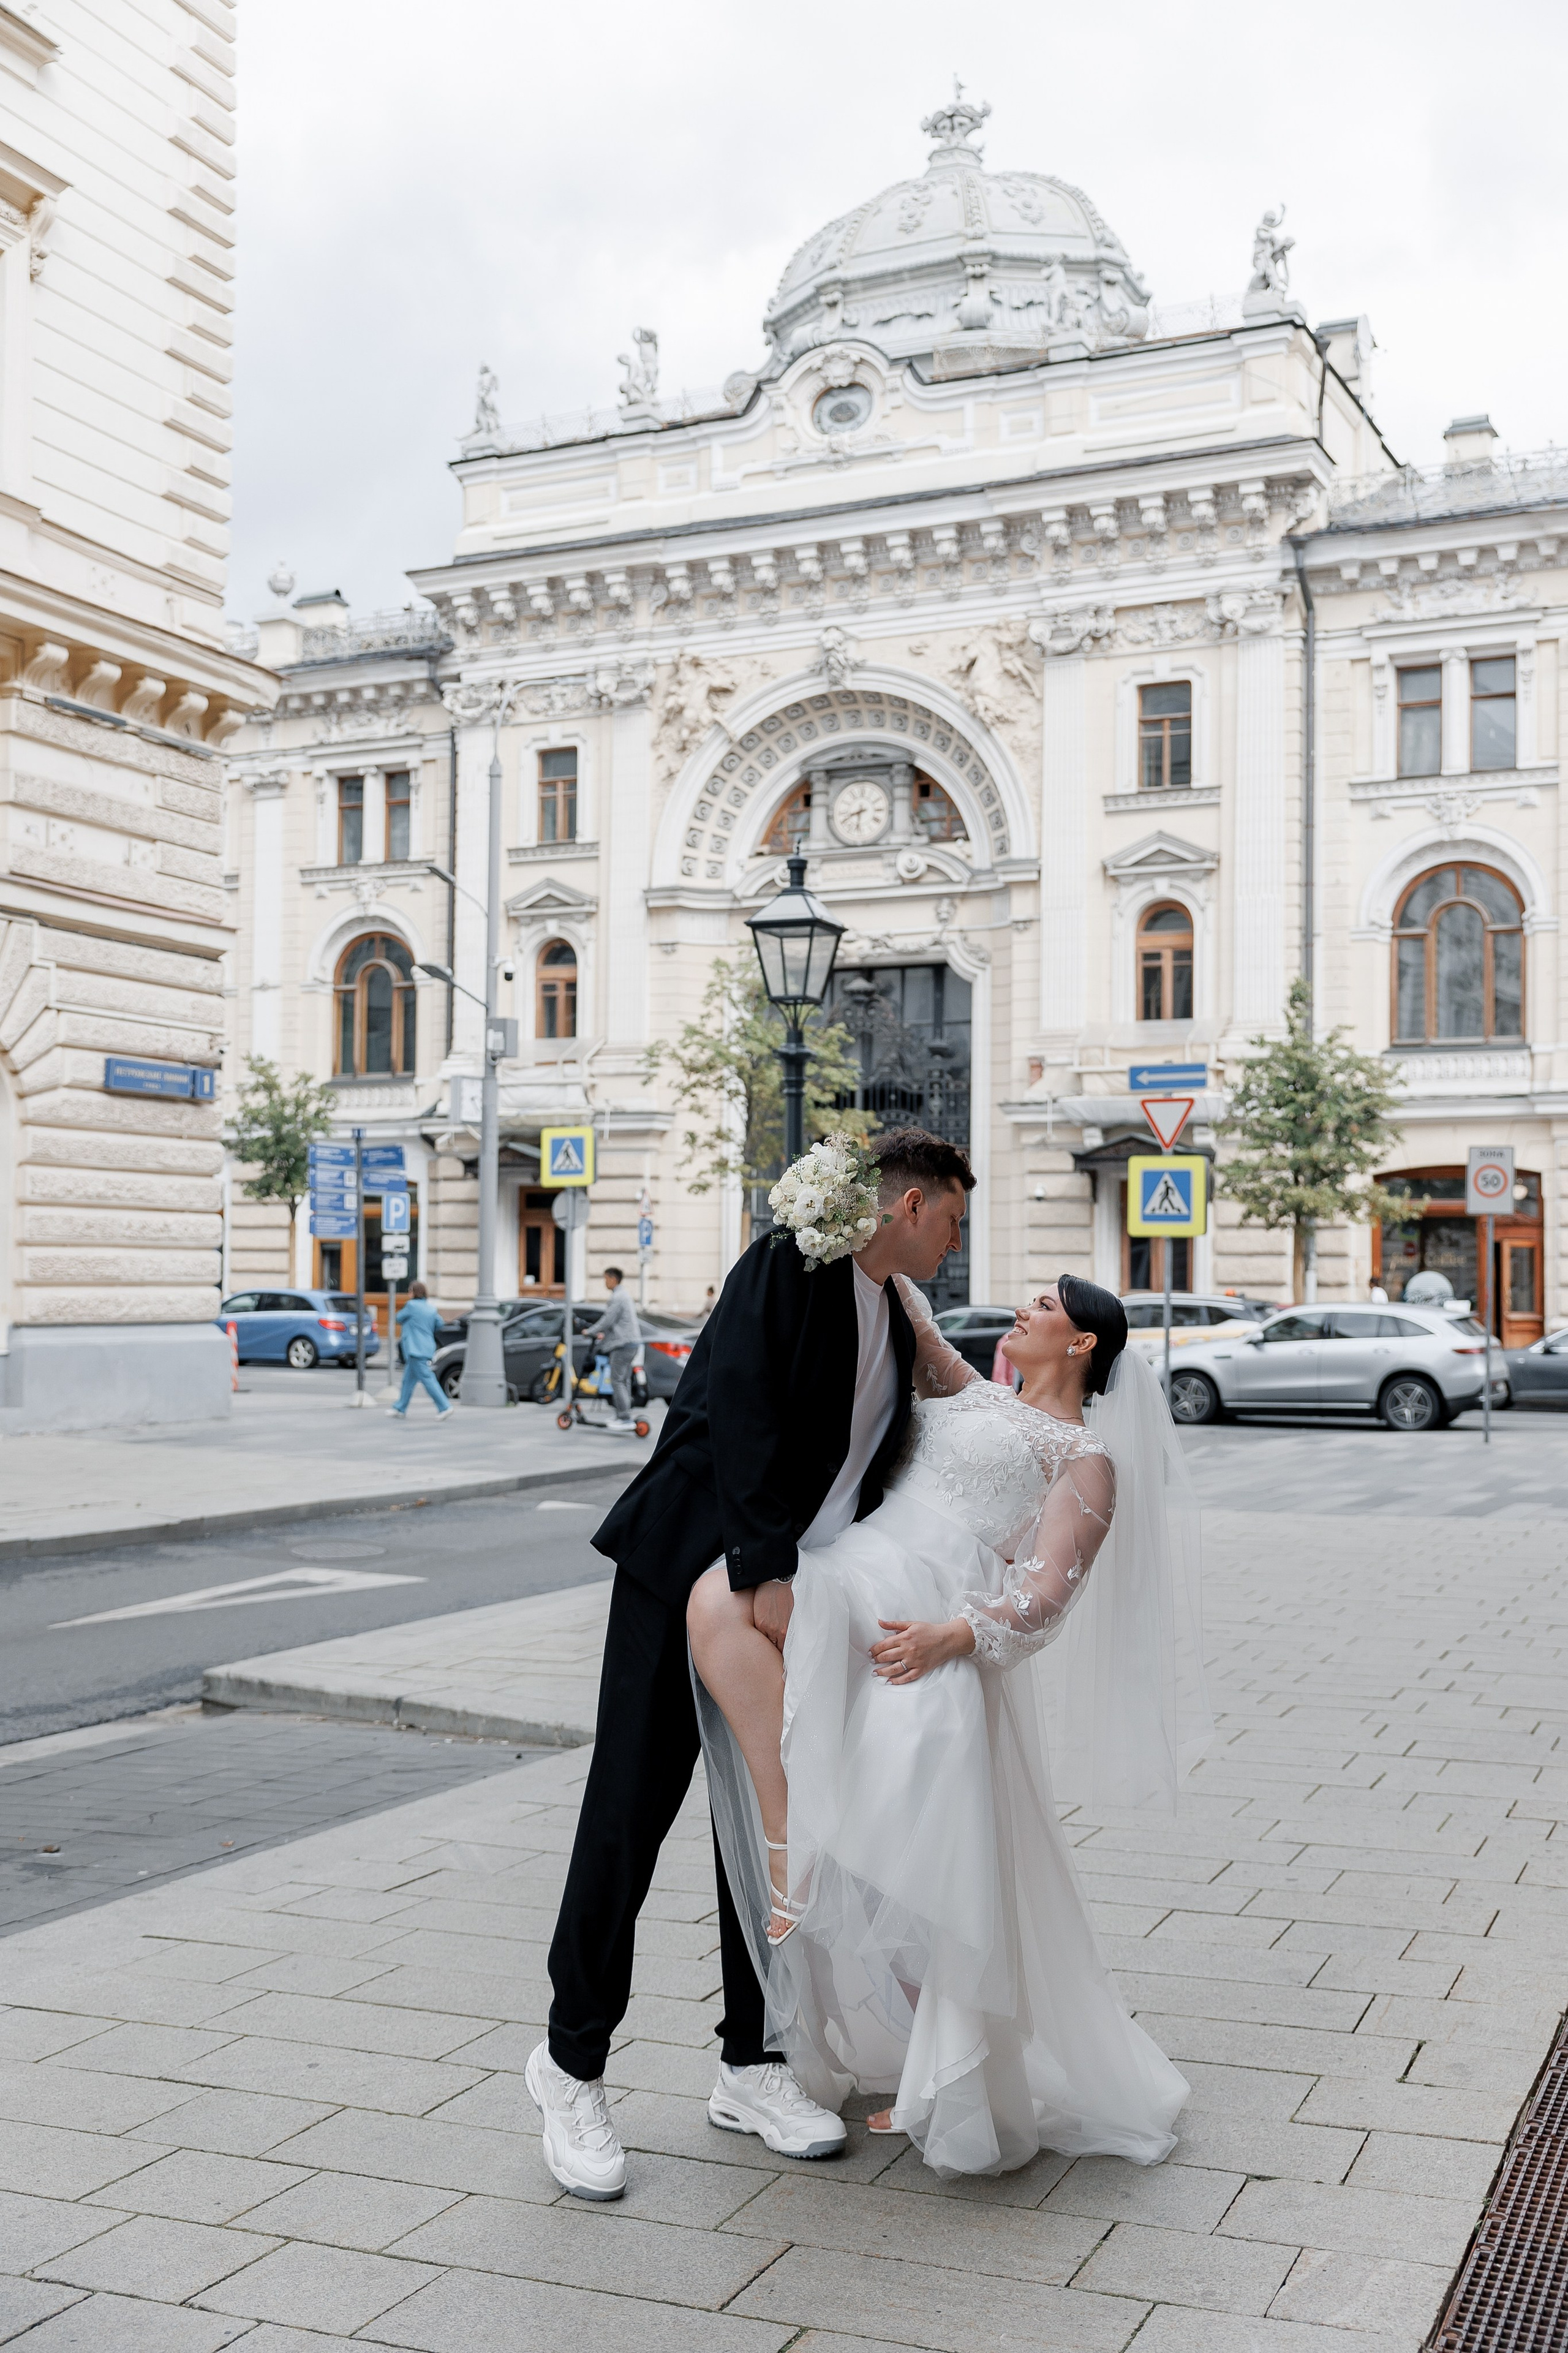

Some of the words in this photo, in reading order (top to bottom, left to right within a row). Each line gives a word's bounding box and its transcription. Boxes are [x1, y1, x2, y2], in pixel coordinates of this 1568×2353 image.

[203, 1075, 211, 1094] 1
[1480, 1173, 1501, 1188] 50
[389, 1197, 405, 1228] P
